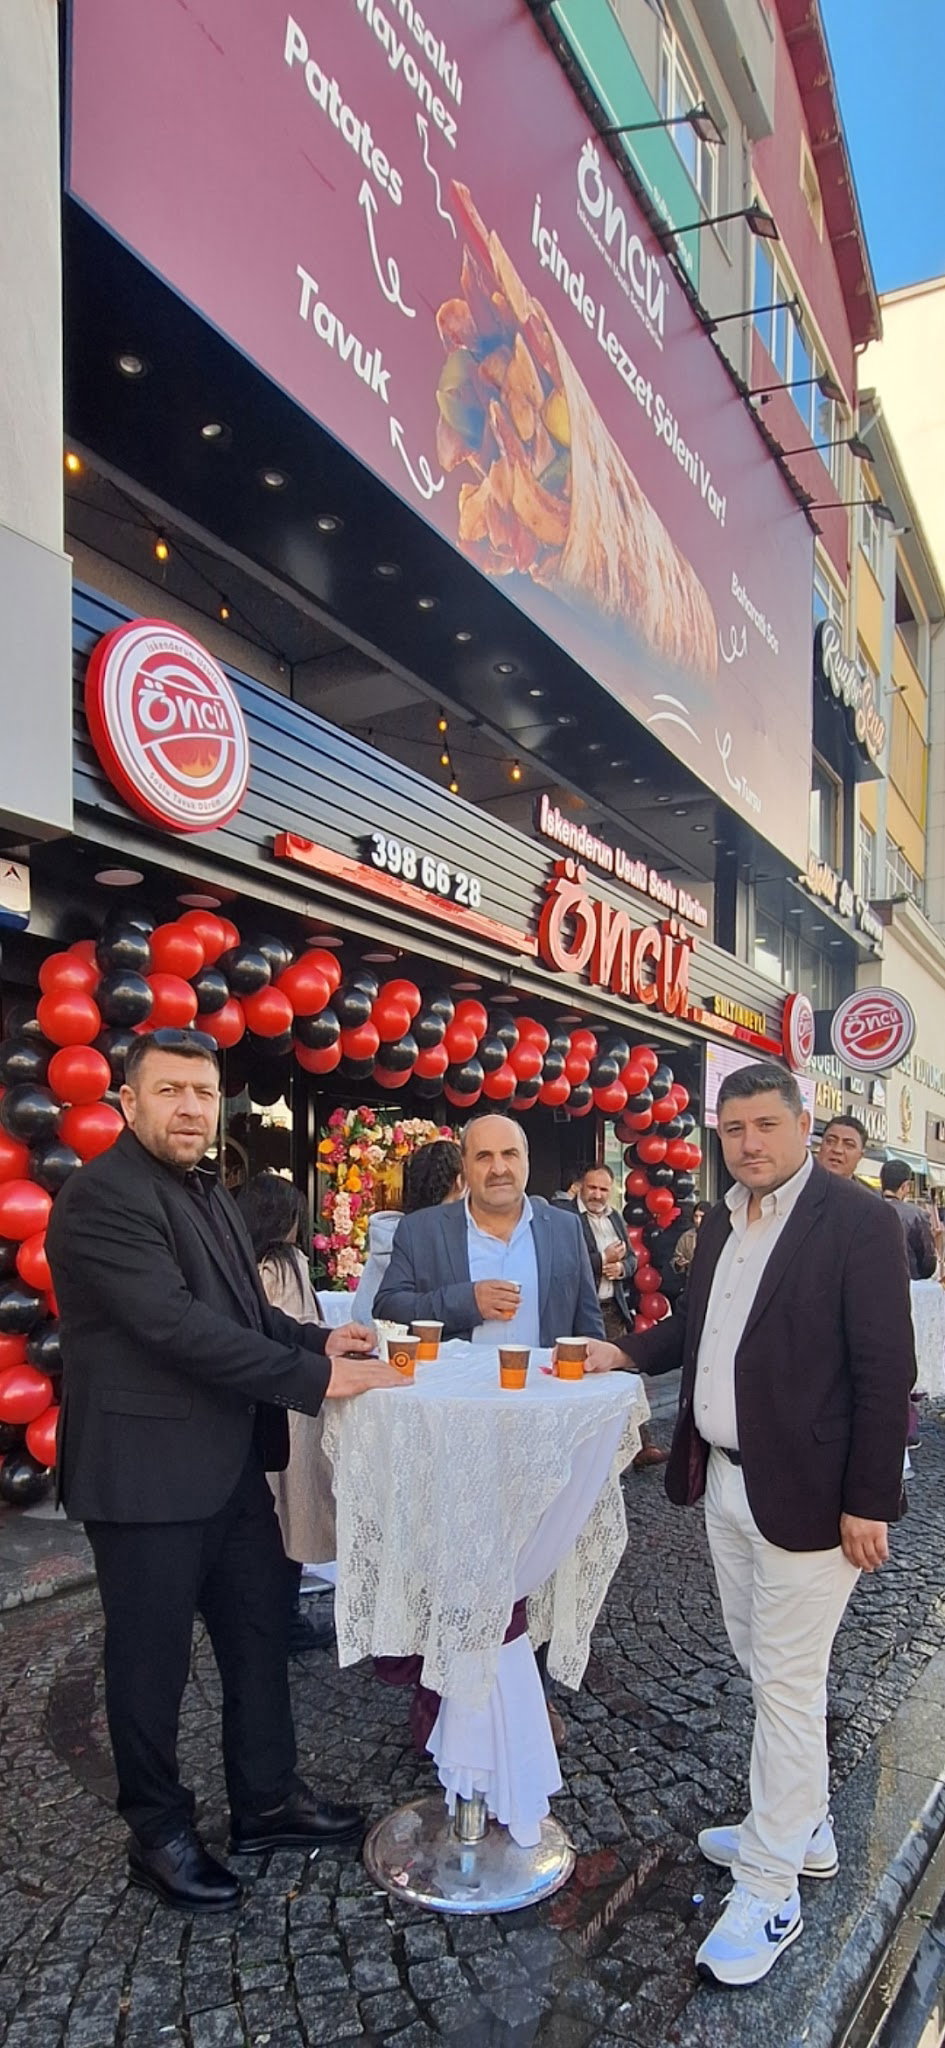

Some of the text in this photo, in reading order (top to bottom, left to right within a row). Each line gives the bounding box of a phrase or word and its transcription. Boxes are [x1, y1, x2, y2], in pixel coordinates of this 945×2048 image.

[285, 15, 403, 206] Patates
[577, 136, 664, 337] Öncü
[297, 264, 391, 404] Tavuk
[532, 192, 727, 528] İçinde Lezzet Şöleni Var!
[138, 678, 229, 731] Öncü
[371, 832, 482, 908] 398 66 28
[539, 857, 693, 1018] Öncü
[615, 847, 647, 892] Usulü
[648, 869, 677, 911] Soslu
[678, 888, 708, 928] Dürüm
[844, 1009, 899, 1039] Öncü
